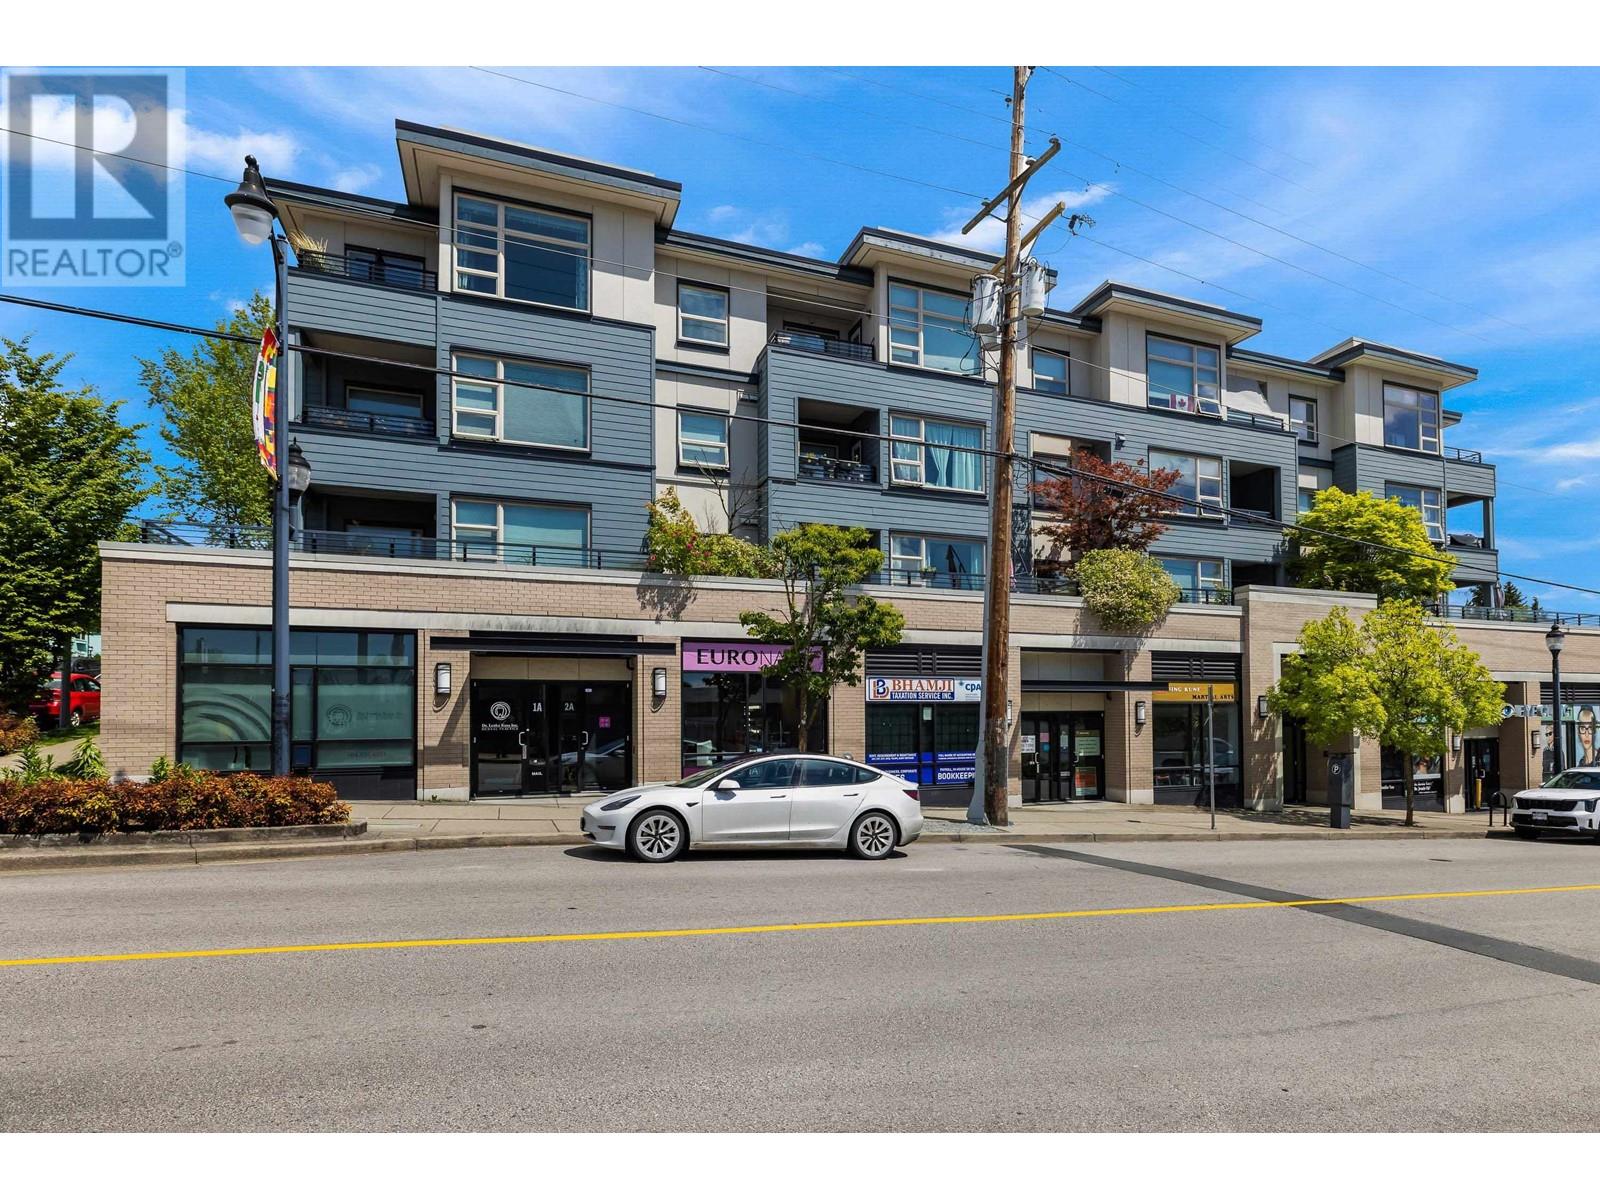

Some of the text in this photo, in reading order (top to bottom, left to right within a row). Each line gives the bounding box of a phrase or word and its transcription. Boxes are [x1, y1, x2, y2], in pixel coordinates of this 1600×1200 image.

[892, 679, 952, 691] BHAMJI
[892, 692, 954, 700] TAXATION SERVICE INC.
[532, 702, 543, 712] 1A
[564, 702, 575, 712] 2A
